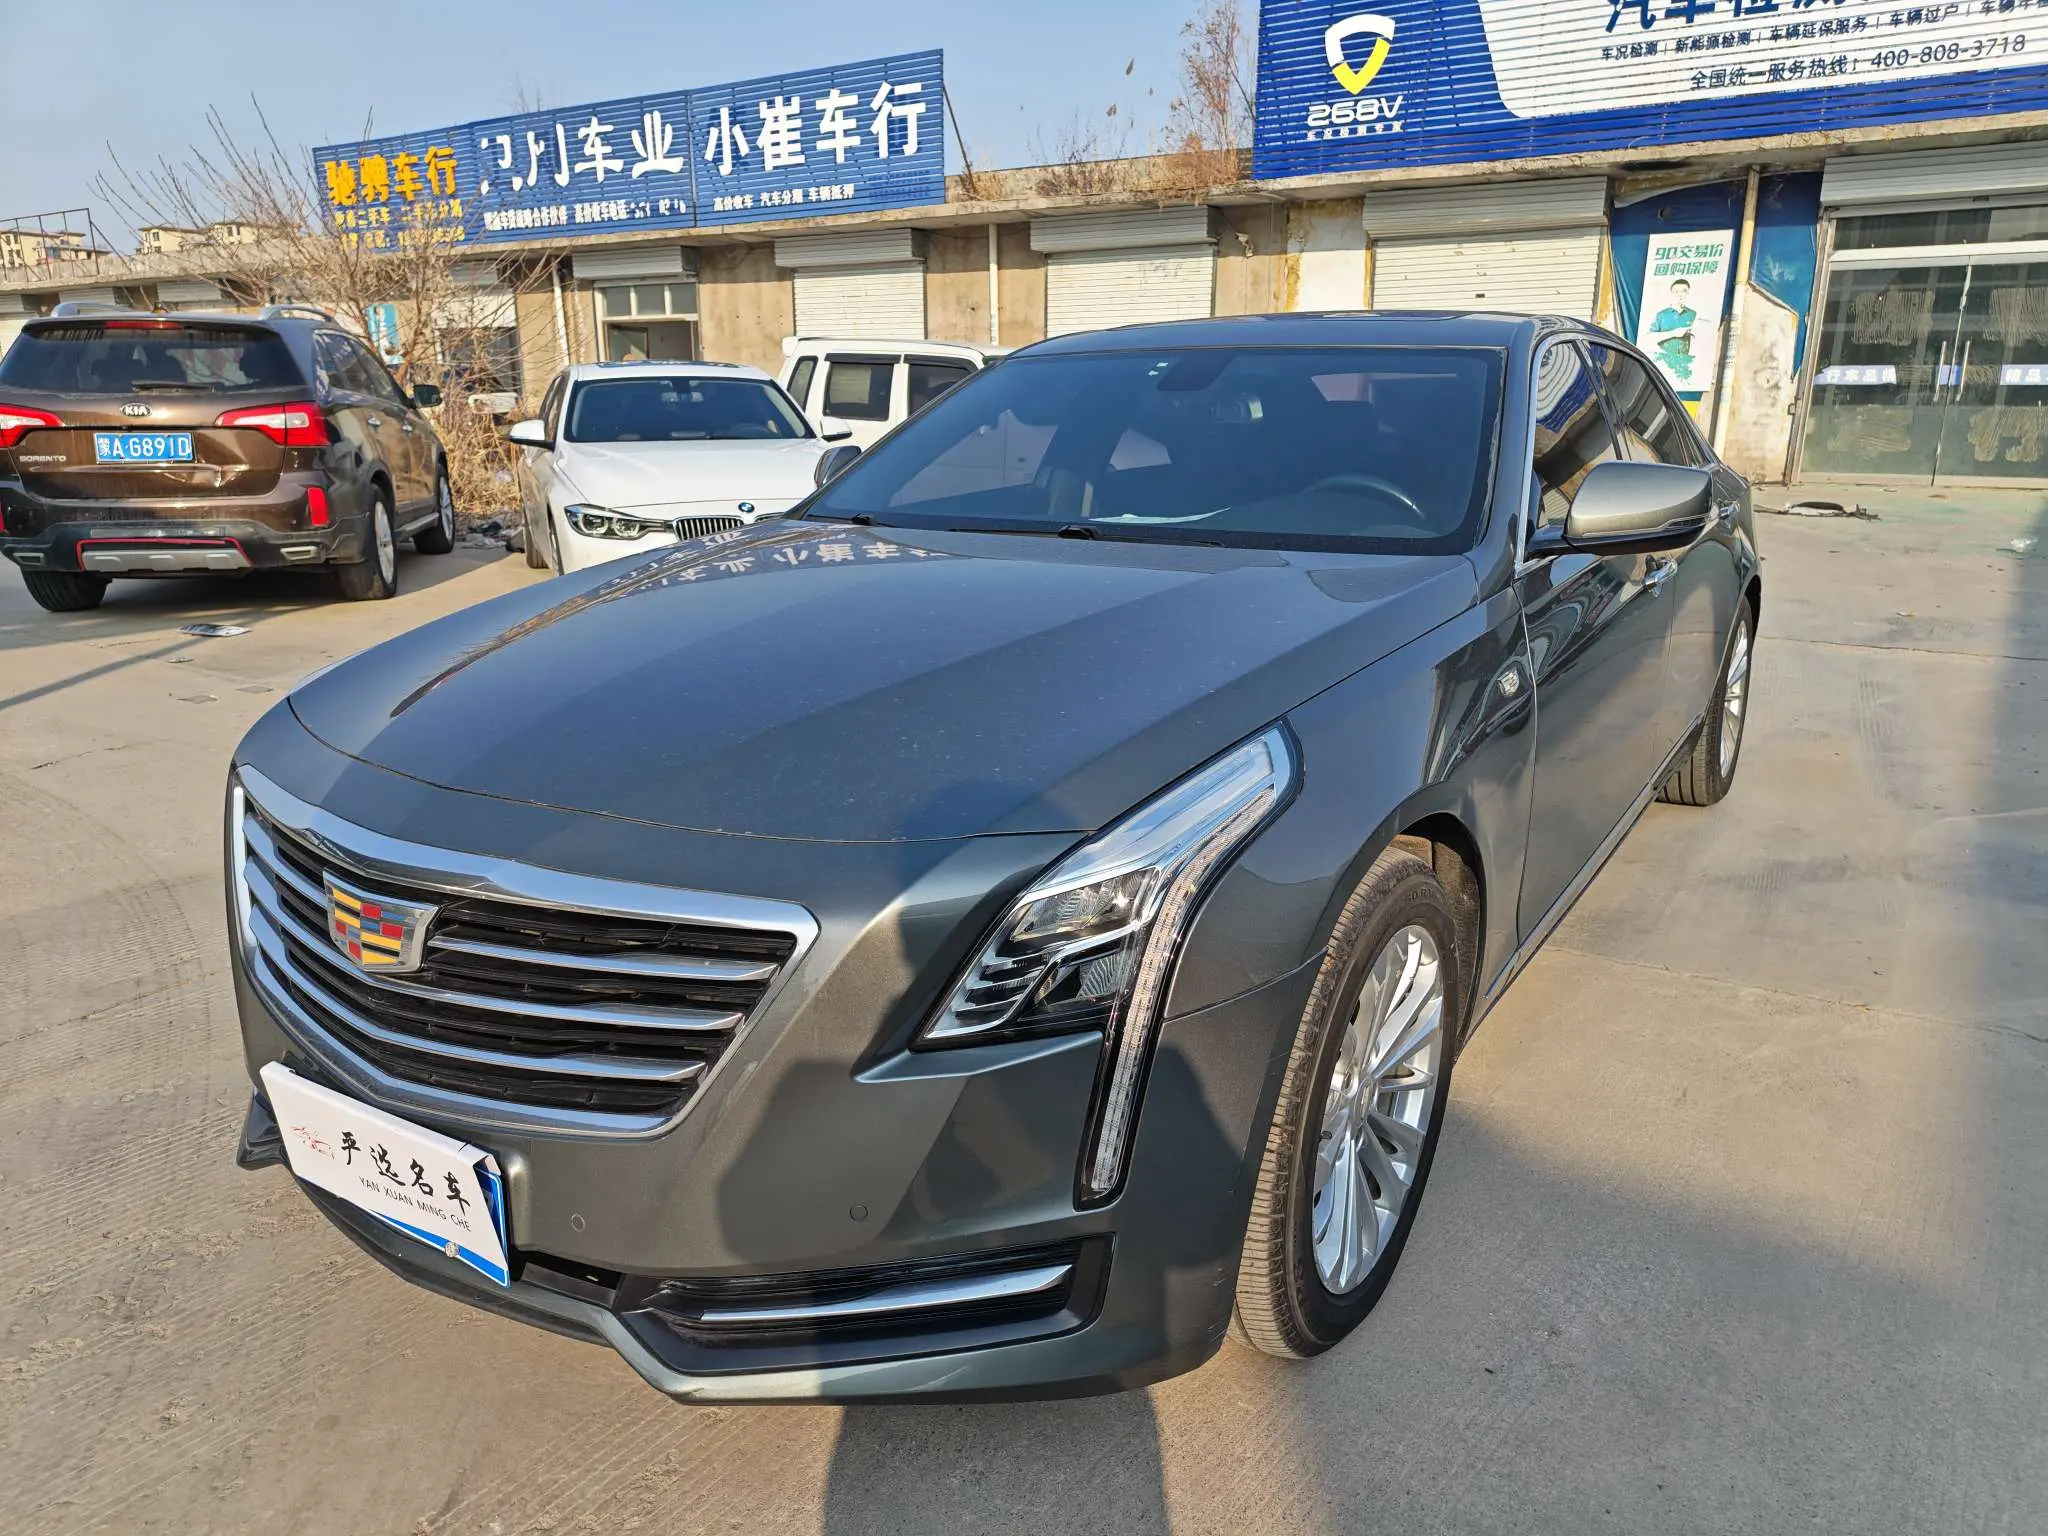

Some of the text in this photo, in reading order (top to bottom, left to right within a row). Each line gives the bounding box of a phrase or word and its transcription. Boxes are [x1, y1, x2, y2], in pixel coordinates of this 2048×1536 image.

[1601, 41, 1658, 61] 车况检测
[1675, 30, 1751, 53] 新能源检测
[1769, 17, 1868, 42] 车辆延保服务
[1889, 5, 1959, 28] 车辆过户
[1870, 34, 2026, 69] 400-808-3718
[703, 81, 926, 176] 小崔车行
[1307, 95, 1403, 127] 268V
[123, 405, 148, 416] KIA
[19, 454, 67, 463] SORENTO
[359, 1176, 472, 1232] YAN XUAN MING CHE
